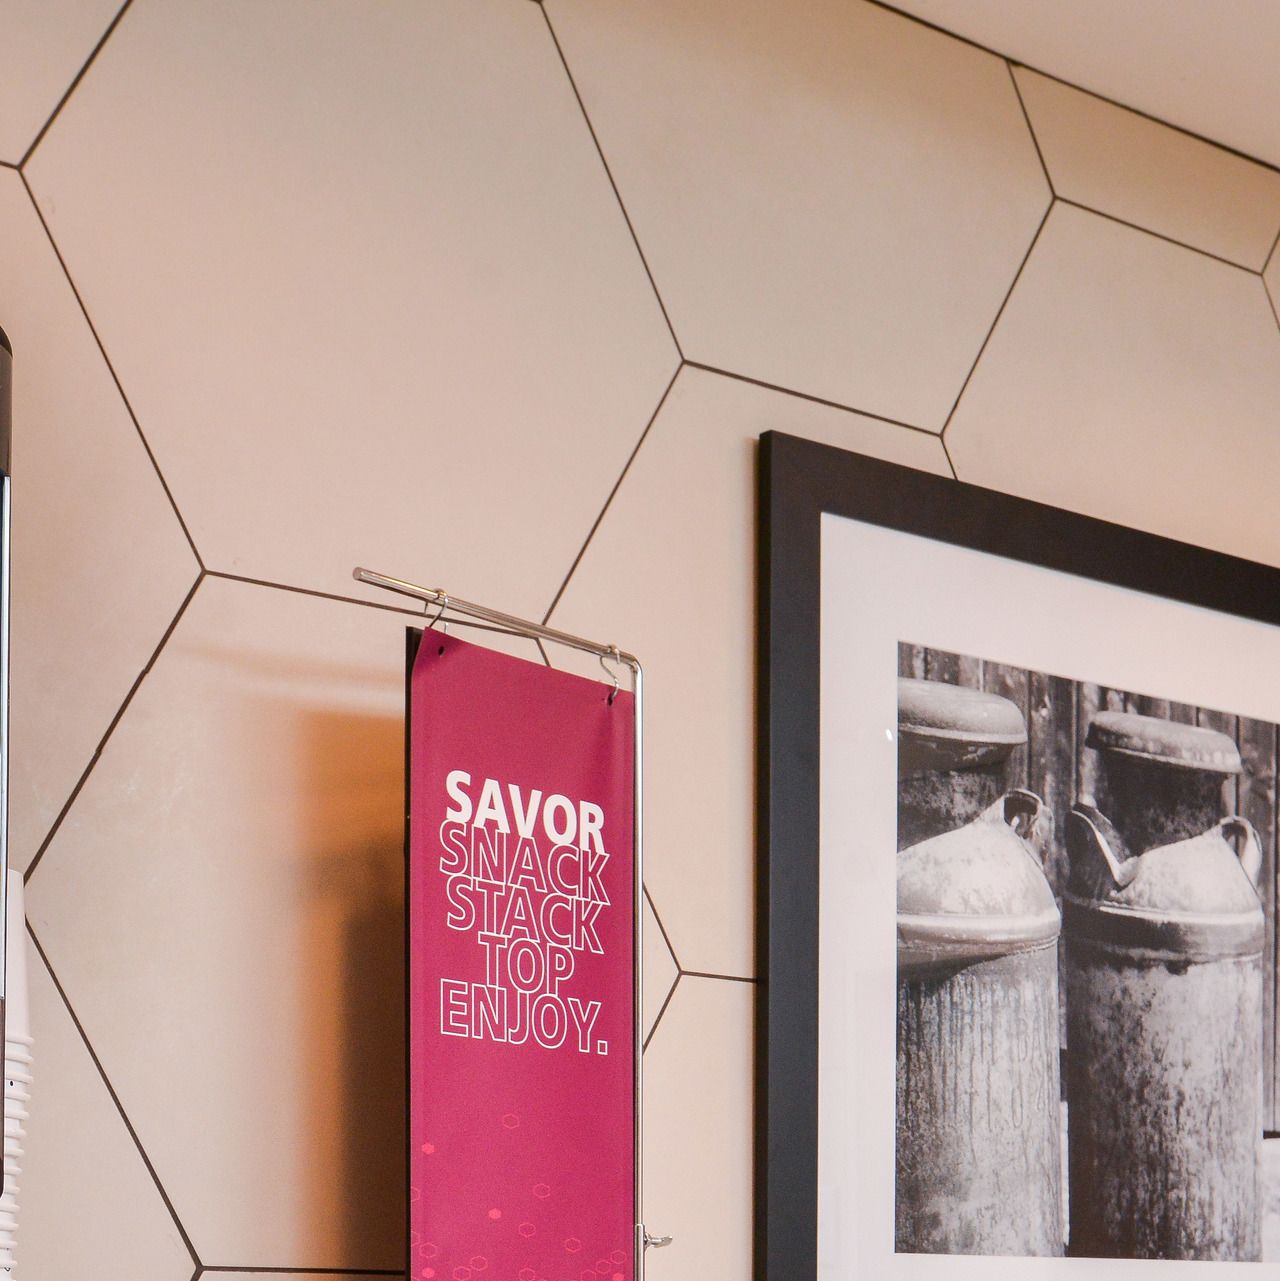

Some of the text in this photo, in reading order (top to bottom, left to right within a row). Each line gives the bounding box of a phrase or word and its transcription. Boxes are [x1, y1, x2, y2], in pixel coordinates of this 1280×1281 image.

[445, 769, 606, 855] SAVOR
[439, 818, 611, 906] SNACK
[446, 873, 605, 954] STACK
[477, 931, 575, 996] TOP
[439, 977, 609, 1056] ENJOY.
